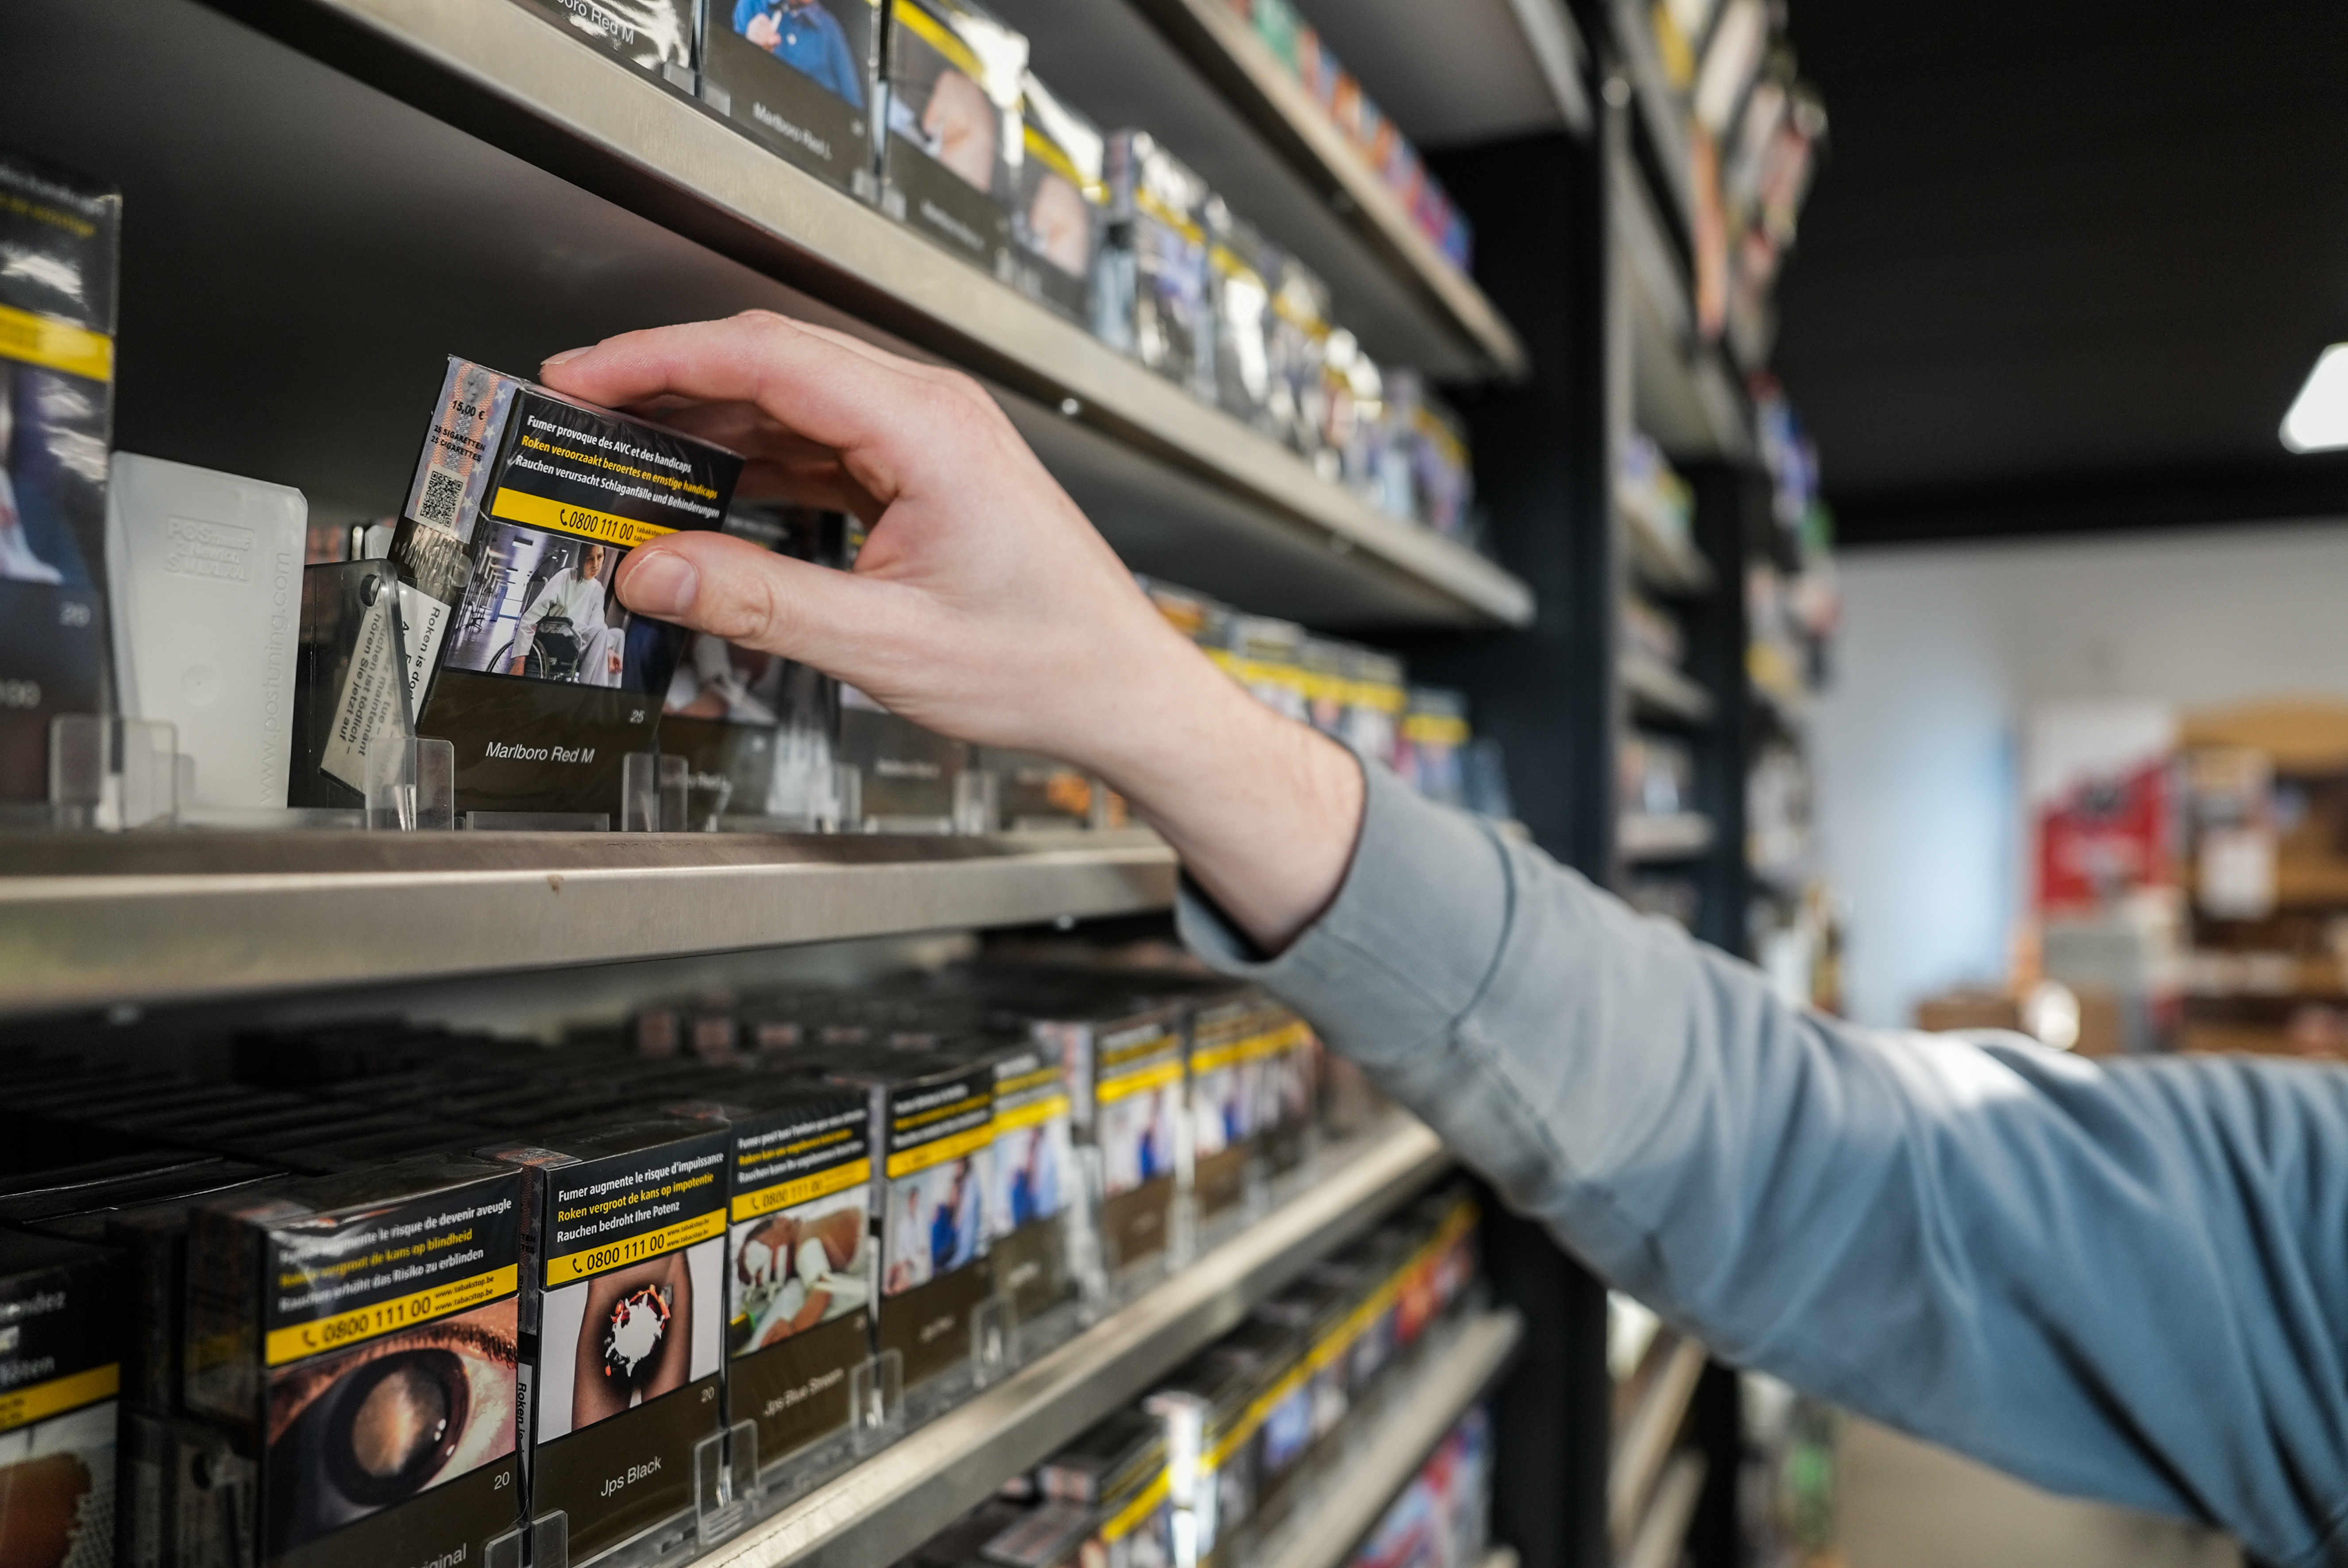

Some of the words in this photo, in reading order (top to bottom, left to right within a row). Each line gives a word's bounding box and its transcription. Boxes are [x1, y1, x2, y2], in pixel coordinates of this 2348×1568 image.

[591, 7, 618, 35] Red
[622, 26, 634, 45] M
[453, 400, 476, 416] 15,00
[479, 411, 485, 420] €
[434, 425, 442, 433] 25
[443, 429, 486, 451] SIGARETTEN
[441, 439, 482, 462] CIGARETTES
[527, 415, 557, 432] Fumer
[556, 426, 597, 445] provoque
[598, 436, 613, 449] des
[613, 442, 631, 455] AVC
[631, 448, 640, 458] et
[640, 449, 654, 462] des
[654, 452, 692, 474] handicaps
[516, 455, 554, 474] Rauchen
[556, 467, 600, 486] verursacht
[600, 478, 652, 500] Schlaganfälle
[653, 493, 668, 505] und
[667, 494, 720, 518] Behinderungen
[521, 435, 550, 452] Roken
[552, 446, 602, 467] veroorzaakt
[602, 458, 641, 478] beroertes
[642, 471, 652, 481] en
[653, 474, 683, 490] ernstige
[683, 480, 718, 500] handicaps
[569, 511, 598, 532] 0800
[600, 518, 618, 537] 111
[619, 523, 633, 540] 00
[364, 613, 382, 654] hören
[421, 607, 441, 652] Roken
[260, 552, 291, 804] www.postuning.com
[357, 657, 369, 680] Sie
[416, 655, 426, 668] is
[347, 680, 359, 715] jetzt
[363, 674, 375, 693] ist
[340, 717, 350, 742] auf
[348, 695, 367, 744] tödlich
[358, 676, 386, 756] maintenant
[629, 709, 645, 724] 25
[485, 741, 548, 761] Marlboro
[551, 746, 580, 763] Red
[581, 747, 595, 763] M
[559, 1187, 588, 1202] Fumer
[590, 1175, 633, 1195] augmente
[635, 1171, 643, 1183] le
[645, 1167, 670, 1181] risque
[671, 1152, 724, 1174] d'impuissance
[558, 1207, 587, 1222] Roken
[589, 1196, 626, 1214] vergroot
[628, 1192, 638, 1204] de
[641, 1188, 660, 1201] kans
[661, 1185, 672, 1197] op
[673, 1172, 714, 1193] impotentie
[763, 1189, 788, 1207] 0800
[377, 1226, 390, 1241] le
[390, 1221, 423, 1238] risque
[424, 1216, 438, 1230] de
[438, 1207, 475, 1226] devenir
[476, 1198, 512, 1217] aveugle
[557, 1224, 597, 1243] Rauchen
[599, 1213, 633, 1232] bedroht
[635, 1209, 651, 1222] Ihre
[653, 1202, 680, 1217] Potenz
[369, 1251, 384, 1266] de
[385, 1246, 410, 1261] kans
[411, 1243, 426, 1256] op
[426, 1228, 472, 1251] blindheid
[587, 1247, 620, 1270] 0800
[624, 1239, 645, 1260] 111
[650, 1234, 664, 1252] 00
[370, 1273, 392, 1289] das
[392, 1264, 424, 1283] Risiko
[425, 1261, 438, 1274] zu
[438, 1248, 484, 1271] erblinden
[322, 1313, 369, 1343] 0800
[376, 1304, 405, 1327] 111
[411, 1296, 431, 1318] 00
[435, 1275, 494, 1299] www.tabakstop.be
[435, 1287, 494, 1312] www.tabacstop.be
[518, 1383, 527, 1424] Roken
[700, 1386, 714, 1403] 20
[494, 1471, 510, 1490] 20
[601, 1476, 624, 1497] Jps
[627, 1456, 661, 1484] Black
